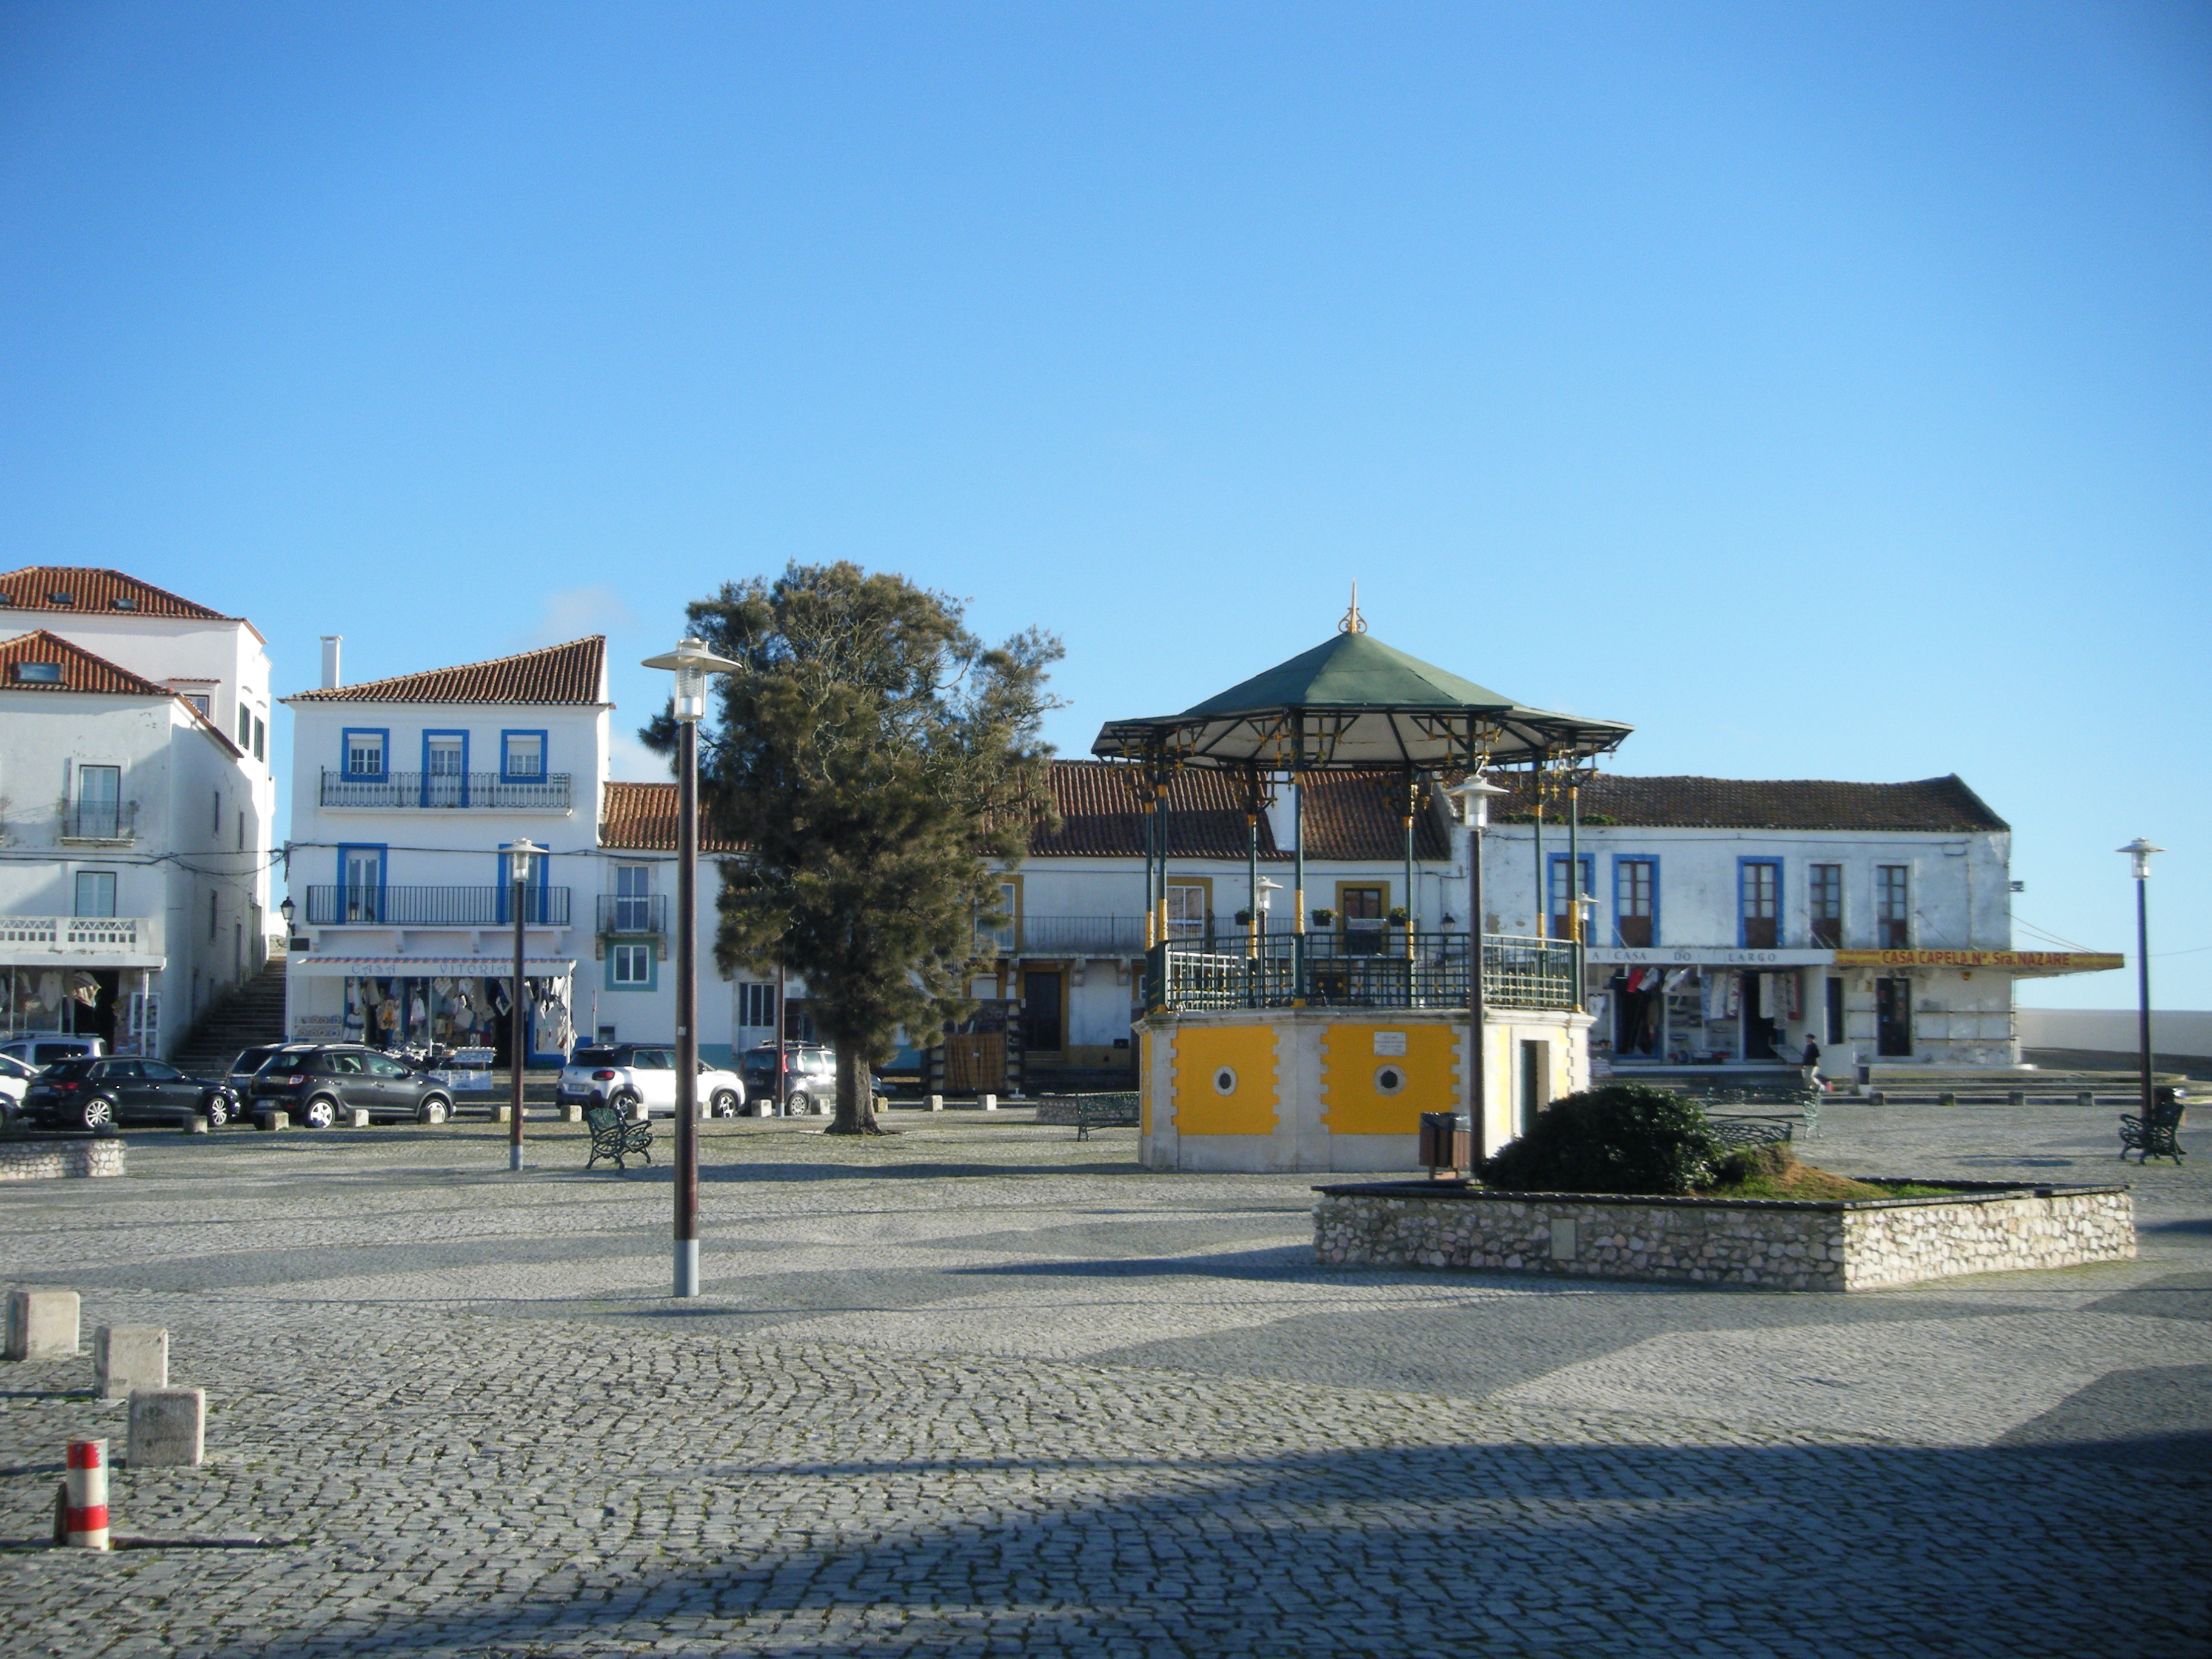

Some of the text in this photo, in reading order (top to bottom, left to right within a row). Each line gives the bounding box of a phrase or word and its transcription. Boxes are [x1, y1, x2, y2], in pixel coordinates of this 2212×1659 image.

[1592, 951, 1776, 962] A CASA DO LARGO
[1882, 950, 1914, 964] CASA
[1918, 951, 1968, 965] CAPELA
[351, 964, 508, 976] CASA VITORIA
